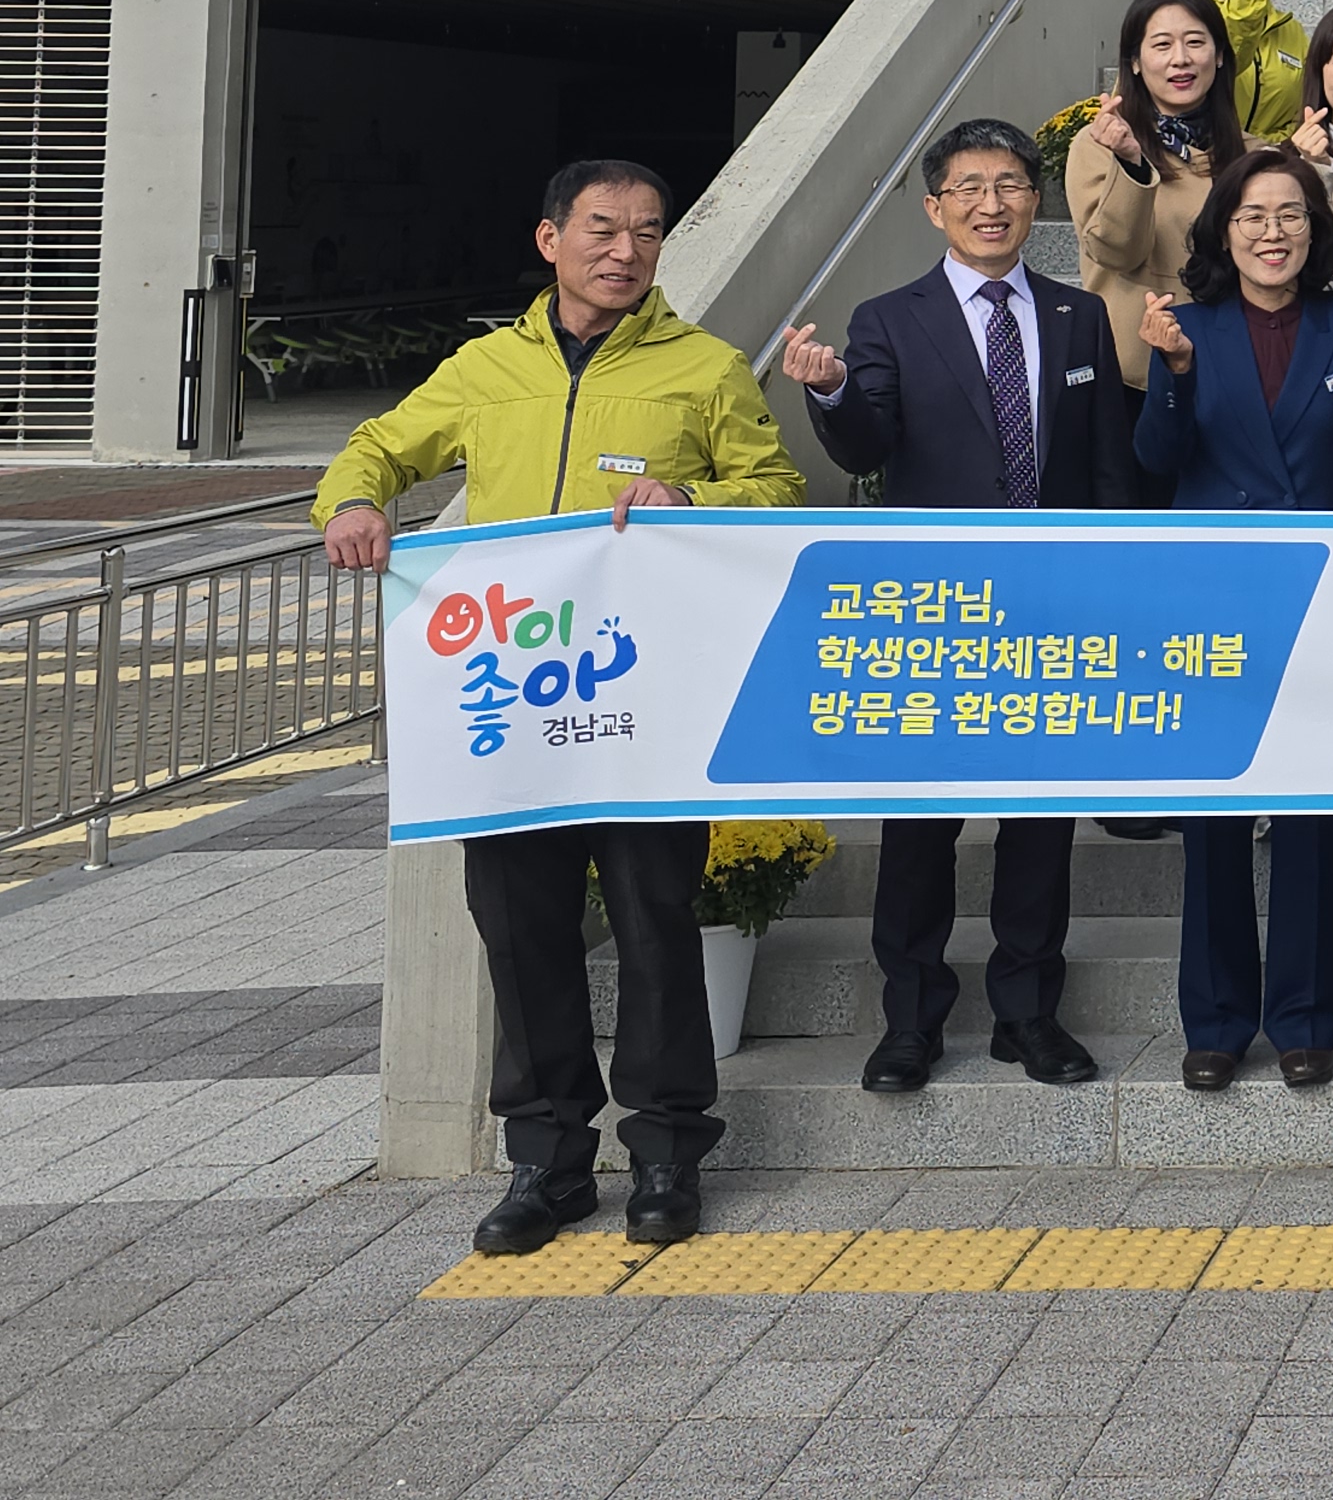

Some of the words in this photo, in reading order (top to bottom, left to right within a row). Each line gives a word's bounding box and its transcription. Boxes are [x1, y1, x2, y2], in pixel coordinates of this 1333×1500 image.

[427, 583, 574, 656] 아이
[820, 579, 1004, 624] 교육감님,
[818, 634, 1118, 680] 학생안전체험원
[1162, 633, 1248, 678] 해봄
[542, 712, 636, 747] 경남교육
[809, 690, 940, 736] 방문을
[951, 690, 1182, 736] 환영합니다!
